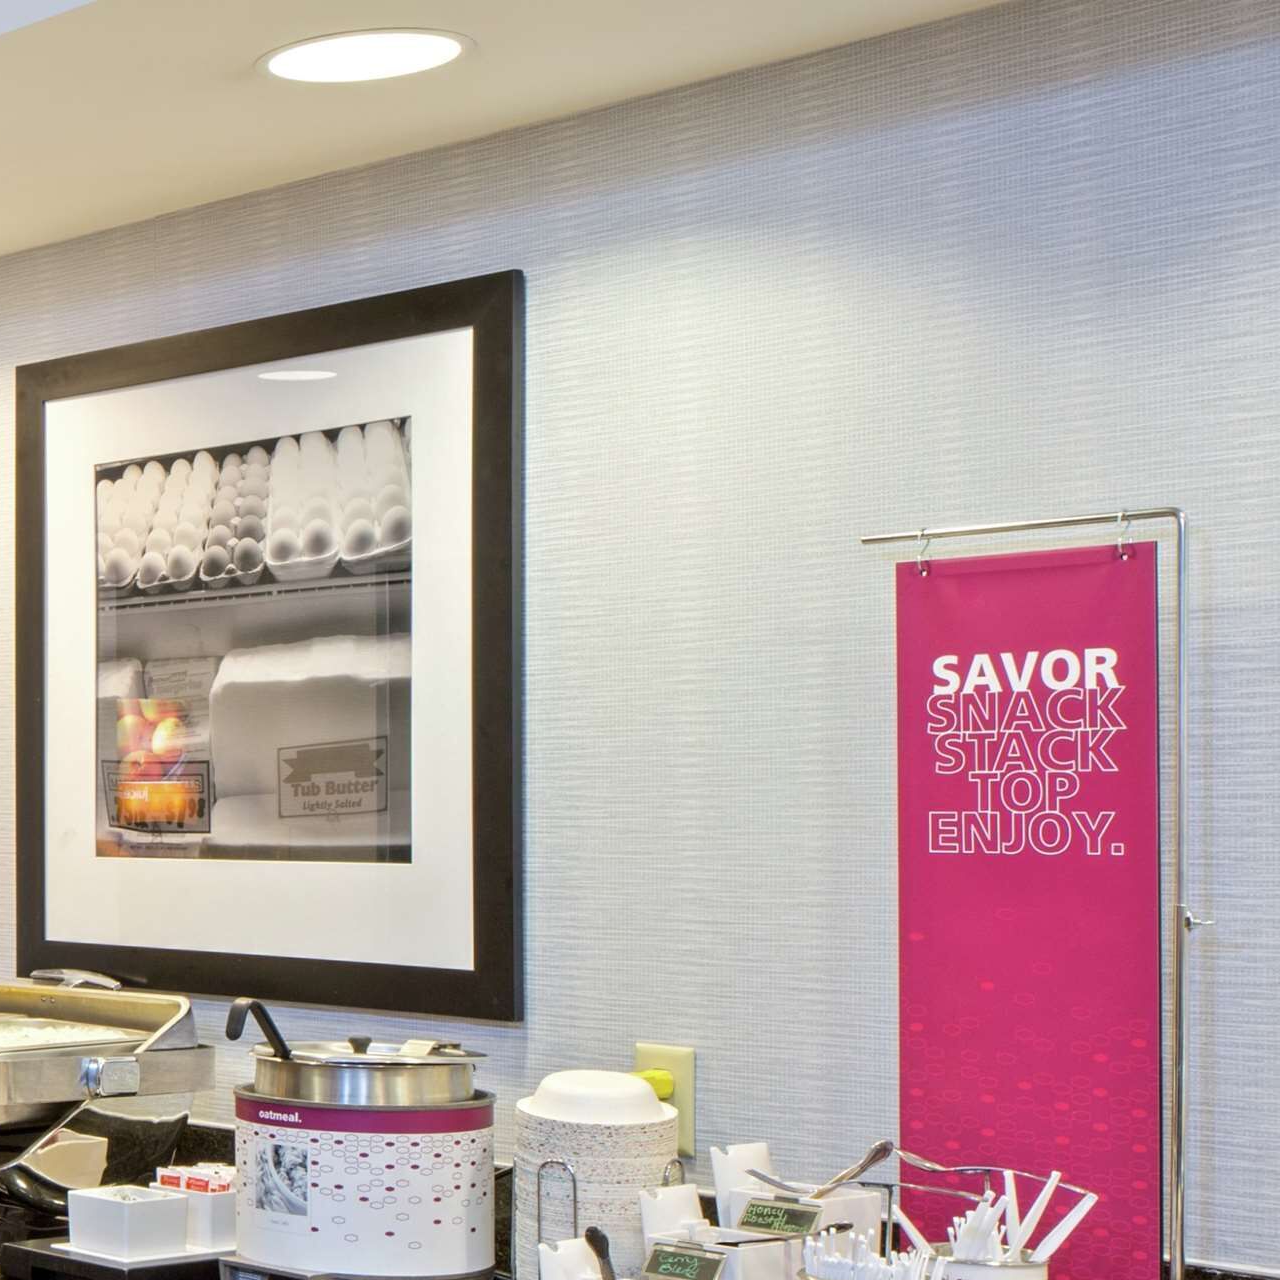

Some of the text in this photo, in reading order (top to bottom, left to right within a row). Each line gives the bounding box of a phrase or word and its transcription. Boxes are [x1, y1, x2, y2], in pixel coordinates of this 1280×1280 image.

[932, 647, 1120, 695] SAVOR
[926, 685, 1128, 735] SNACK
[934, 728, 1120, 775] STACK
[291, 779, 379, 797] Tub Butter
[969, 770, 1081, 814] TOP
[928, 811, 1125, 856] ENJOY.
[258, 1109, 303, 1123] oatmeal.
